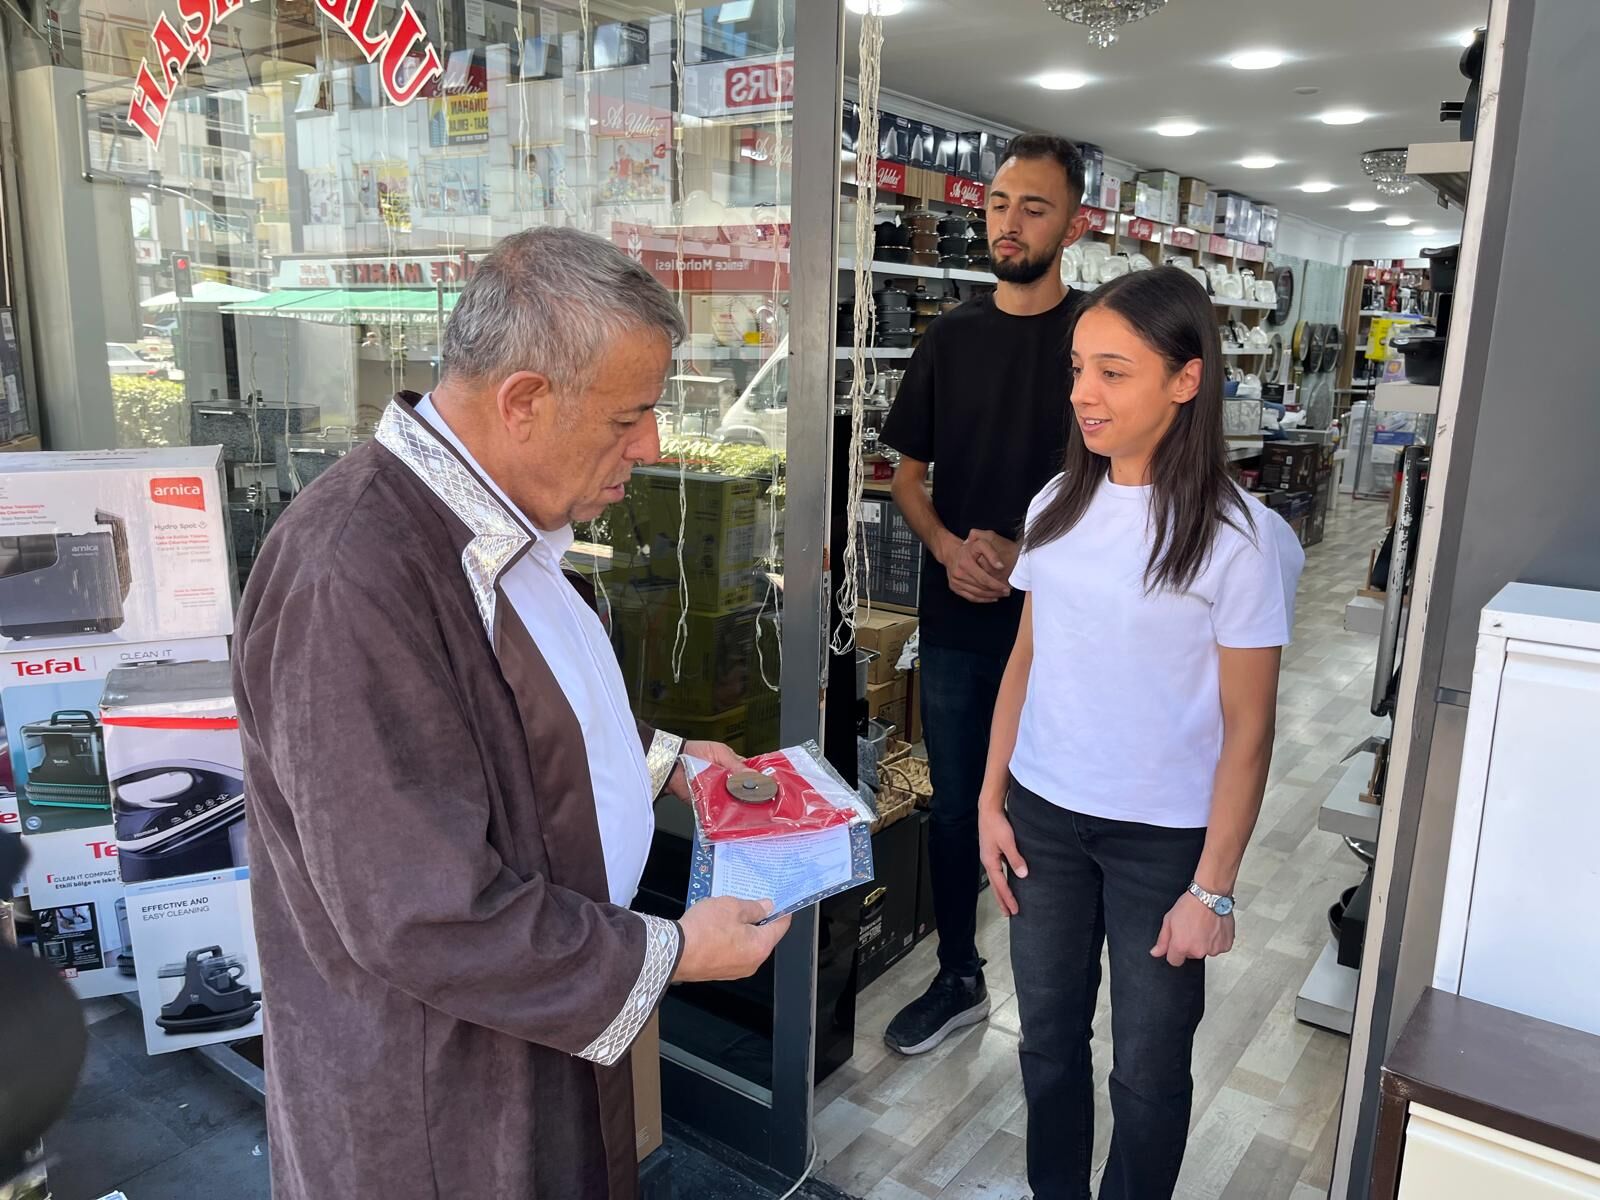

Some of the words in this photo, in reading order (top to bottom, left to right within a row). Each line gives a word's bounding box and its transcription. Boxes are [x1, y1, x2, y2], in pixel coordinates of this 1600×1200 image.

[154, 483, 201, 496] arnica
[120, 650, 159, 661] CLEAN
[163, 649, 173, 657] IT
[11, 656, 87, 677] Tefal
[53, 874, 76, 883] CLEAN
[84, 869, 117, 879] COMPACT
[141, 900, 188, 913] EFFECTIVE
[190, 896, 209, 906] AND
[143, 911, 165, 922] EASY
[166, 905, 210, 918] CLEANING
